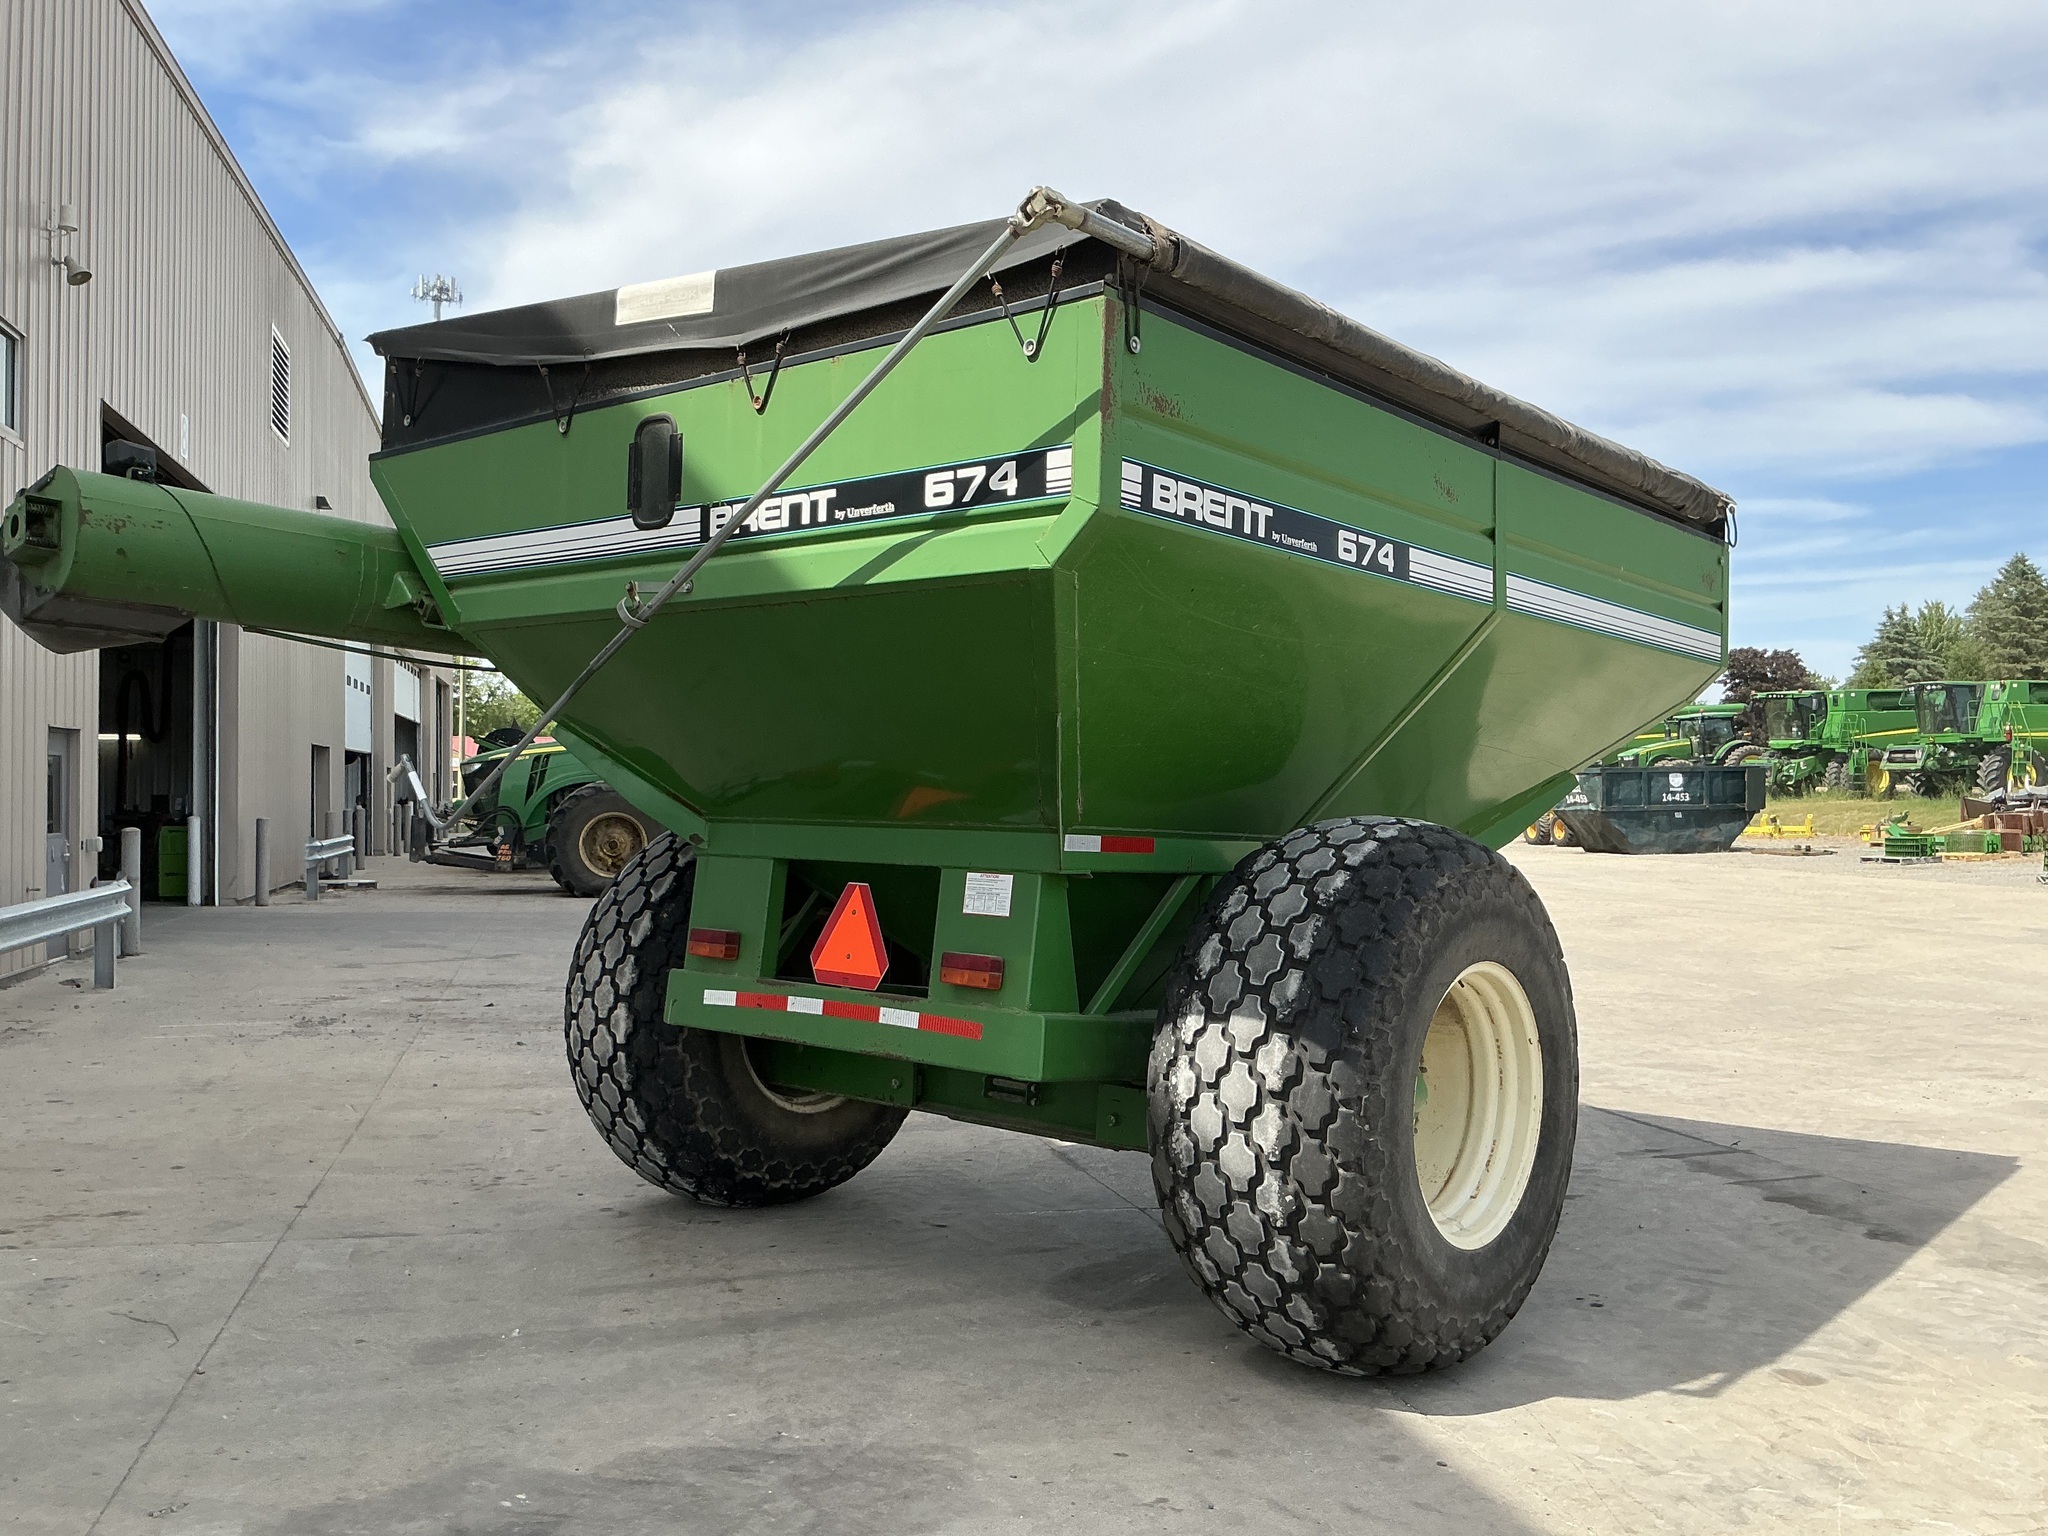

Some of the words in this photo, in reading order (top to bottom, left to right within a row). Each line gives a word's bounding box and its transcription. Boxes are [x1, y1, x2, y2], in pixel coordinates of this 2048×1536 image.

[924, 460, 1018, 508] 674
[834, 508, 846, 520] by
[846, 502, 895, 519] Unverferth
[1152, 473, 1274, 538] BRENT
[1271, 530, 1282, 543] by
[1281, 533, 1318, 553] Unverferth
[1337, 529, 1395, 573] 674
[1662, 792, 1691, 802] 14-453
